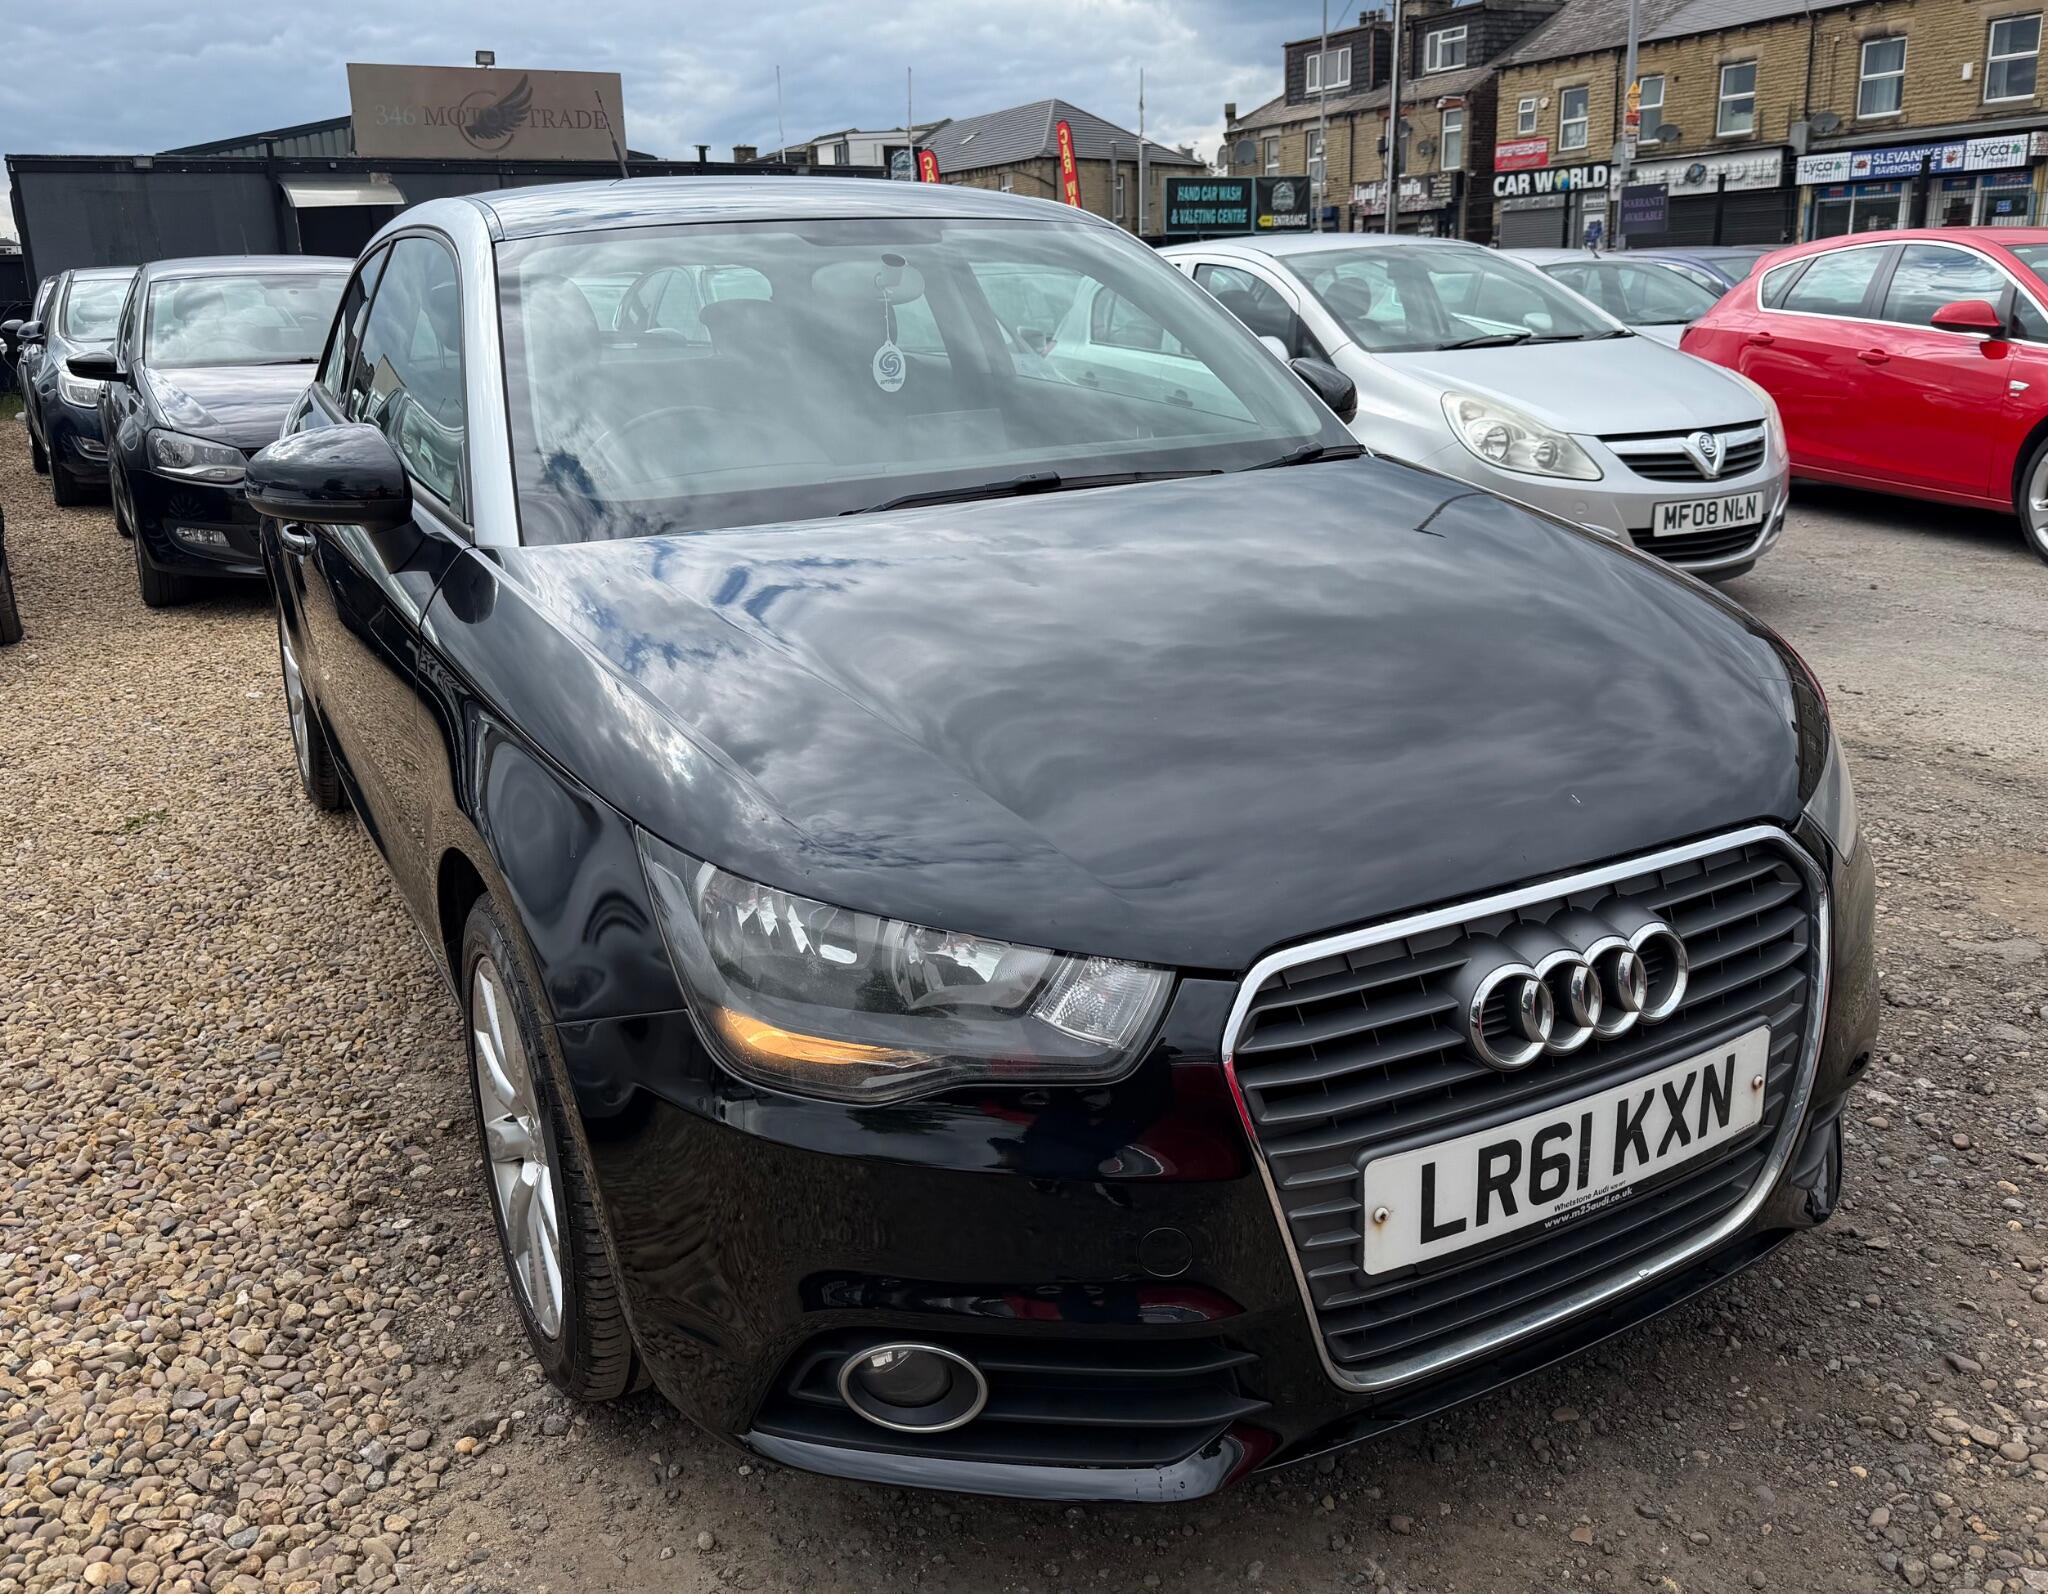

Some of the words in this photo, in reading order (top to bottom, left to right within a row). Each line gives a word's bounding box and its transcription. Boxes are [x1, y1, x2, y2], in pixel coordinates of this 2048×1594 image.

[375, 104, 416, 126] 346
[527, 107, 607, 130] TRADE
[1974, 144, 2009, 160] Lyca
[1803, 160, 1833, 175] Lyca
[1874, 161, 1937, 175] RAVENSTHOE
[1493, 174, 1530, 197] CAR
[1534, 165, 1608, 193] WORLD
[1177, 186, 1200, 201] HAND
[1201, 186, 1218, 201] CAR
[1219, 186, 1242, 201] WASH
[1623, 196, 1665, 209] WARRANTY
[1171, 208, 1178, 224] &
[1179, 208, 1217, 224] VALETING
[1217, 207, 1247, 224] CENTRE
[1273, 214, 1308, 227] ENTRANCE
[1623, 210, 1664, 222] AVAILABLE
[1663, 501, 1718, 530] MF08
[1723, 495, 1757, 523] NLN
[1420, 1111, 1593, 1245] LR61
[1612, 1053, 1736, 1177] KXN
[1593, 1184, 1610, 1198] Audi
[1544, 1187, 1633, 1228] www.m25audi.co.uk
